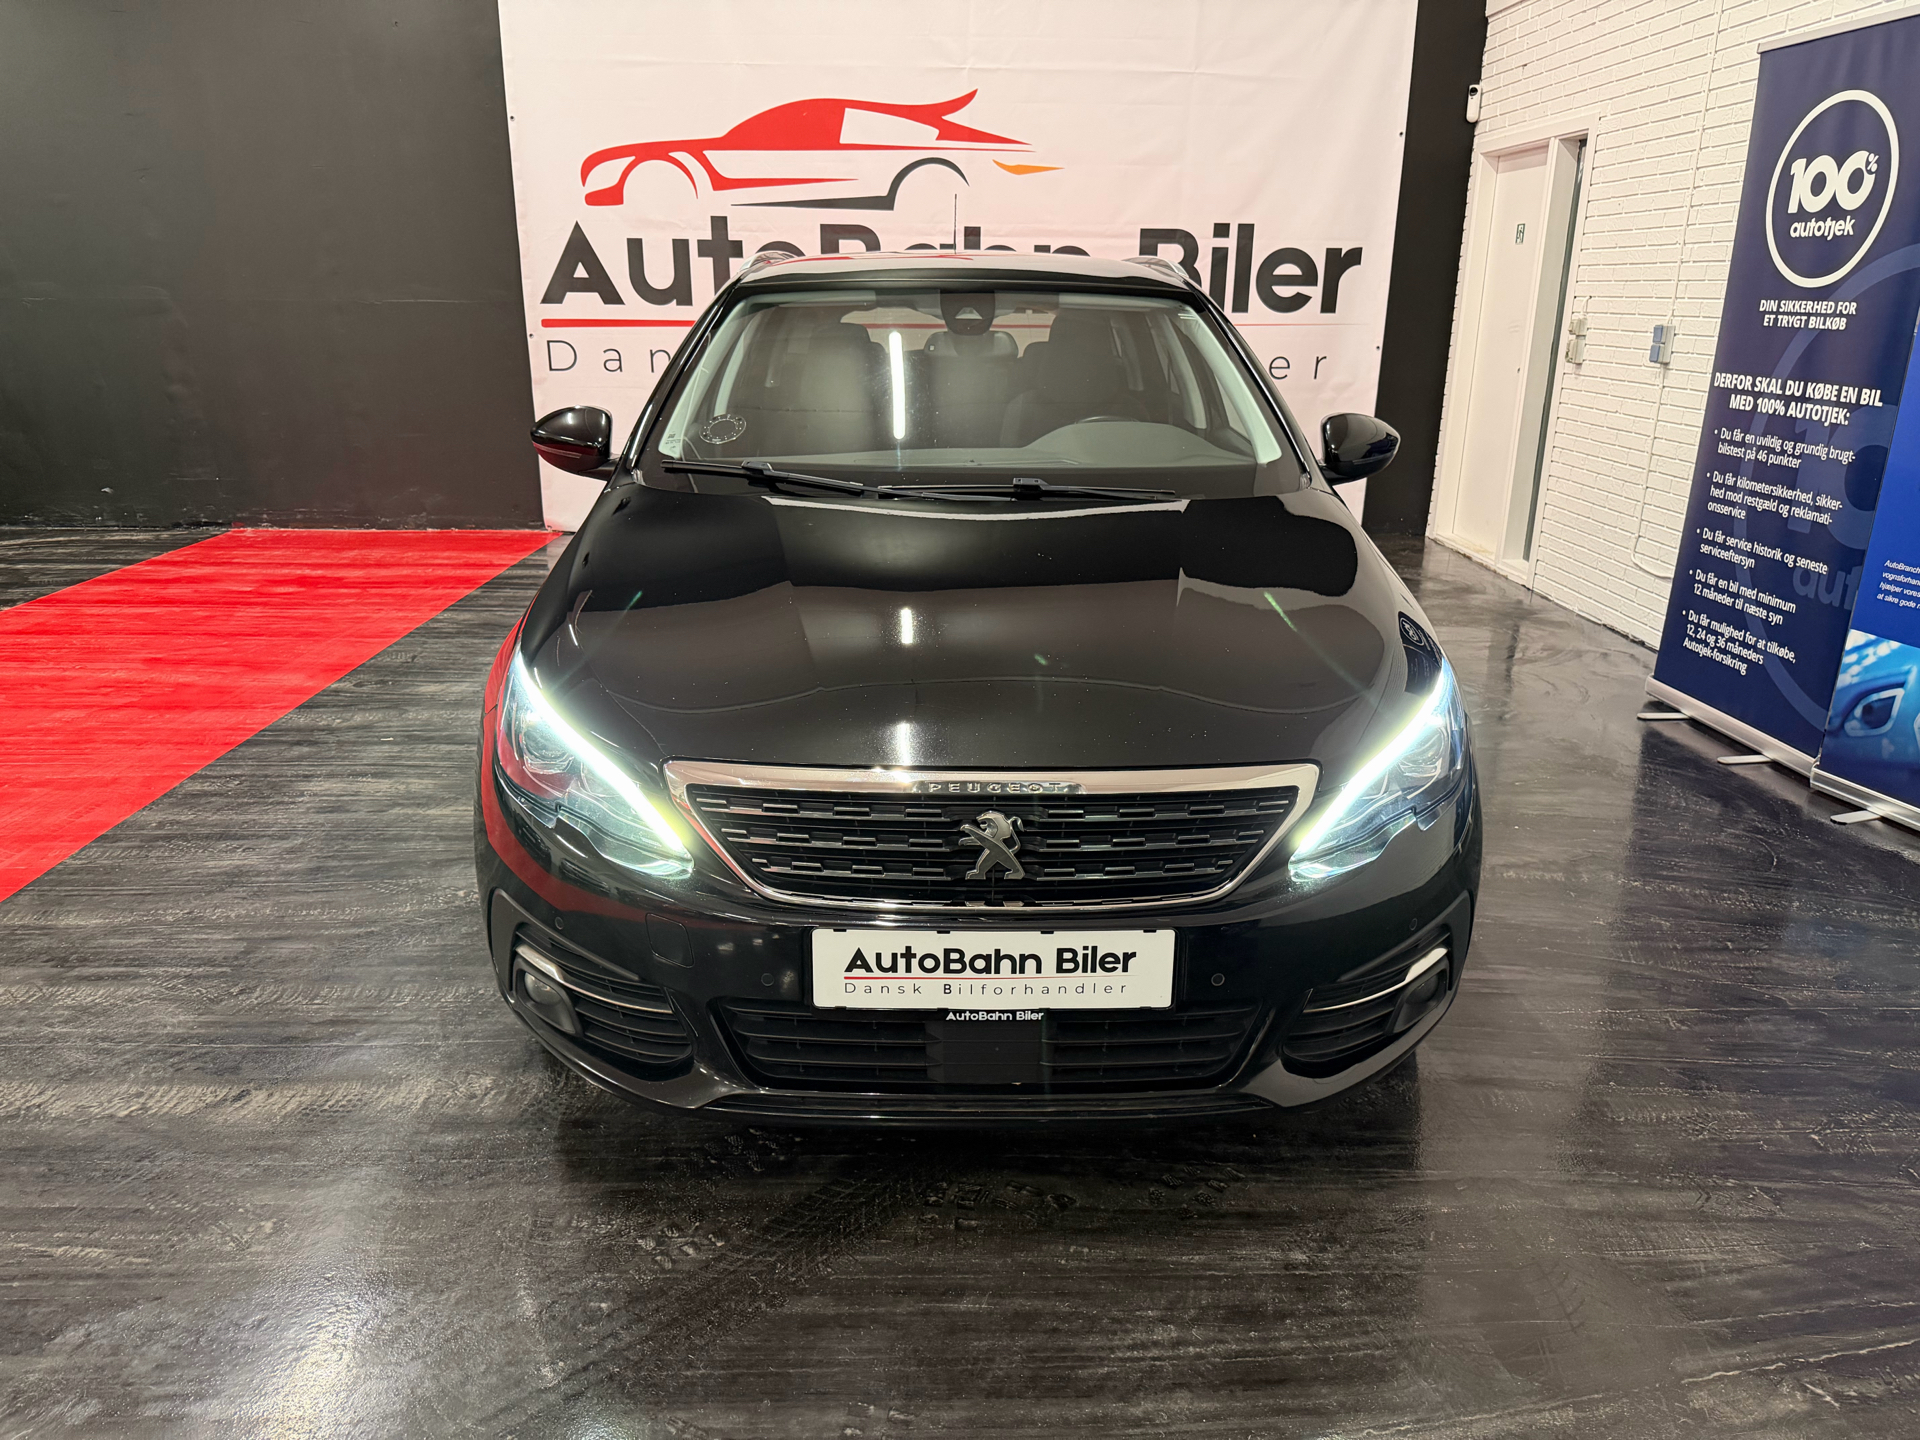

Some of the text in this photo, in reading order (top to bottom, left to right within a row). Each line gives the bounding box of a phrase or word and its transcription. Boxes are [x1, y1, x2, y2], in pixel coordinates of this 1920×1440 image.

[1790, 215, 1856, 241] autotjek
[1759, 299, 1857, 315] DIN SIKKERHED FOR
[1763, 314, 1847, 331] ET TRYGT BILKØB
[546, 339, 671, 374] Dan
[1713, 372, 1883, 407] DERFOR SKAL DU KØBE EN BIL
[1729, 394, 1850, 427] MED 100% AUTOTJEK:
[1718, 442, 1801, 468] bilstest på 46 punkter
[1720, 427, 1855, 464] Du får en uvildig og grundig brugt-
[1710, 485, 1833, 525] hed mod restgæld og reklamati-
[1712, 471, 1843, 511] Du får kilometersikkerhed, sikker-
[1707, 501, 1746, 520] onsservice
[1700, 543, 1755, 570] serviceeftersyn
[1702, 527, 1828, 575] Du får service historik og seneste
[1693, 583, 1784, 626] 12 måneder til næste syn
[1695, 569, 1796, 614] Du får en bil med minimum
[1686, 623, 1764, 665] 12, 24 og 36 måneders
[1688, 609, 1796, 664] Du får mulighed for at tilkøbe,
[928, 782, 1061, 793] PEUGEOT
[844, 945, 1137, 975] AutoBahn Biler
[844, 982, 1127, 996] Dansk Bilforhandler
[946, 1011, 1044, 1022] AutoBahn Biler
